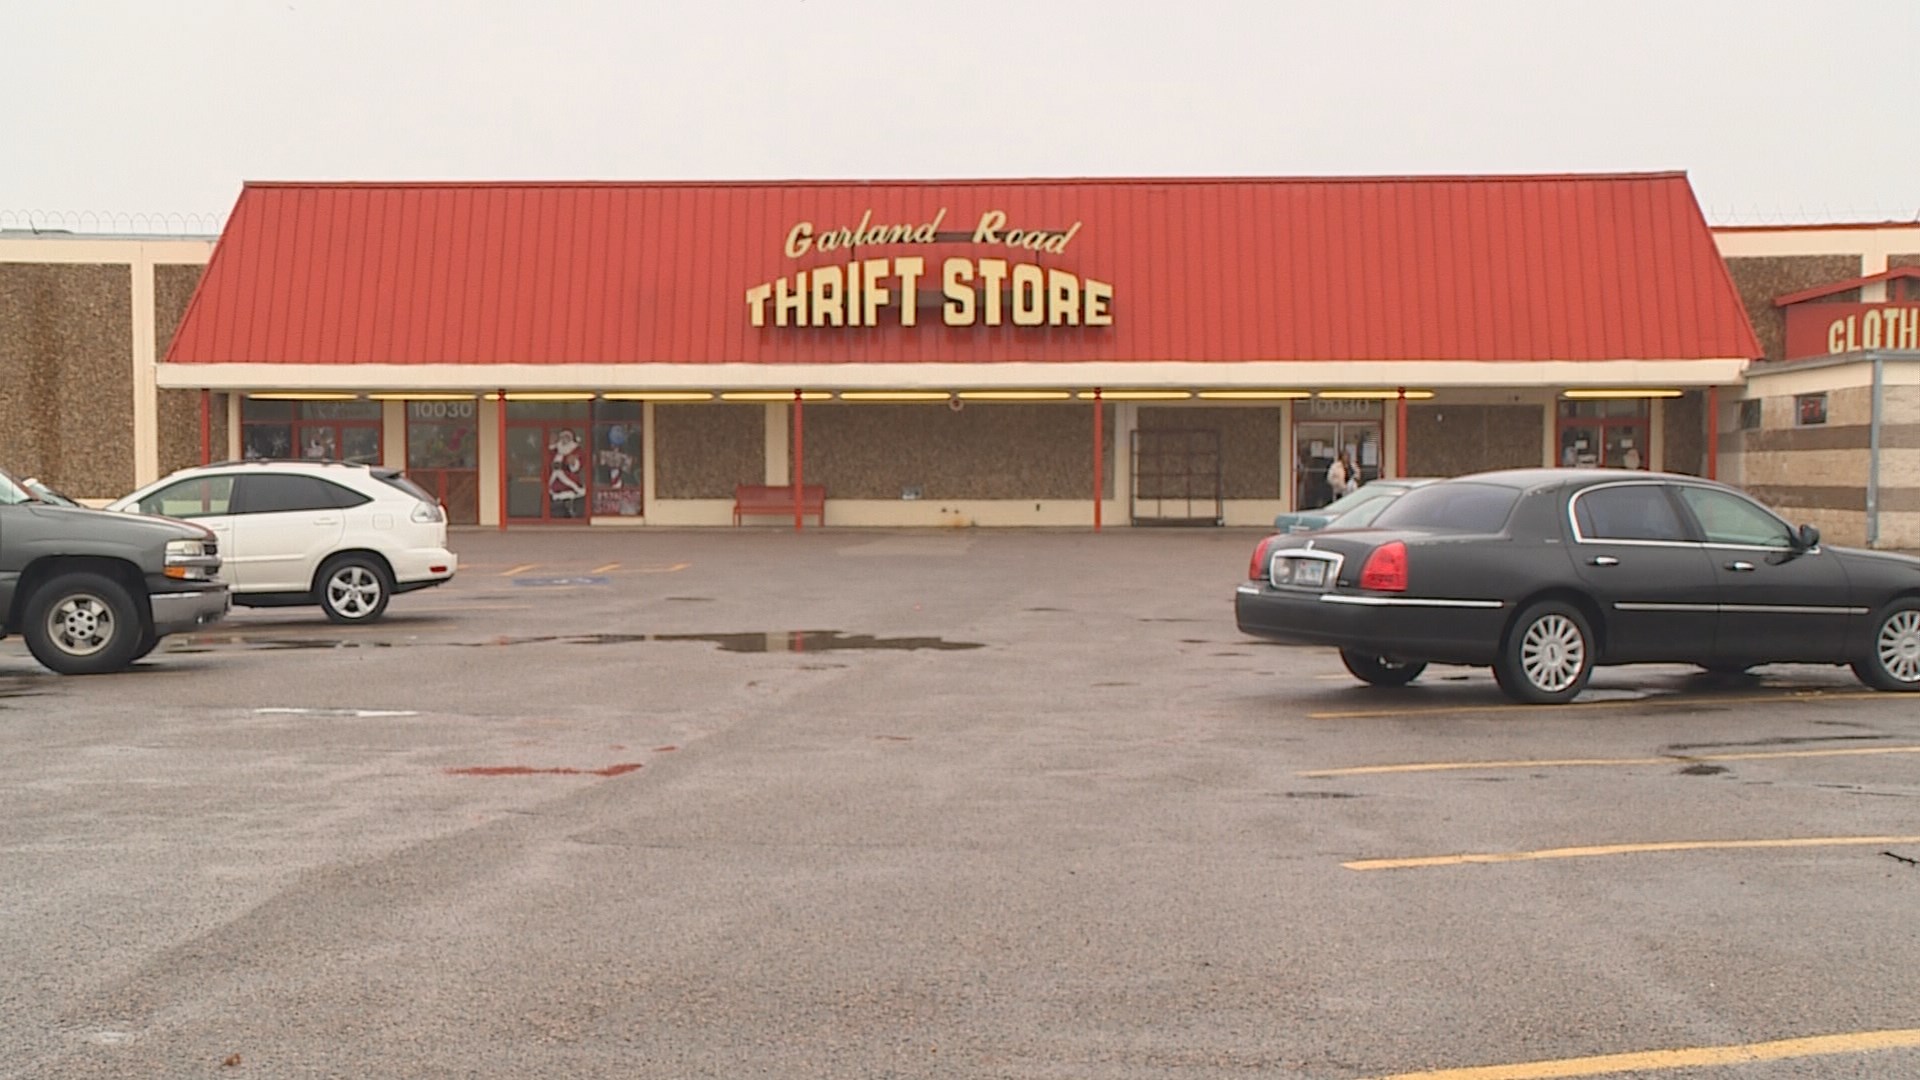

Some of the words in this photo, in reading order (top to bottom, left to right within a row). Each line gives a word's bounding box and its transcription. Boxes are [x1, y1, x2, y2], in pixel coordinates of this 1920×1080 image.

[785, 208, 947, 258] Garland
[973, 211, 1083, 255] Road
[745, 256, 925, 327] THRIFT
[942, 256, 1114, 327] STORE
[1828, 306, 1919, 354] CLOTH
[415, 401, 472, 417] 10030
